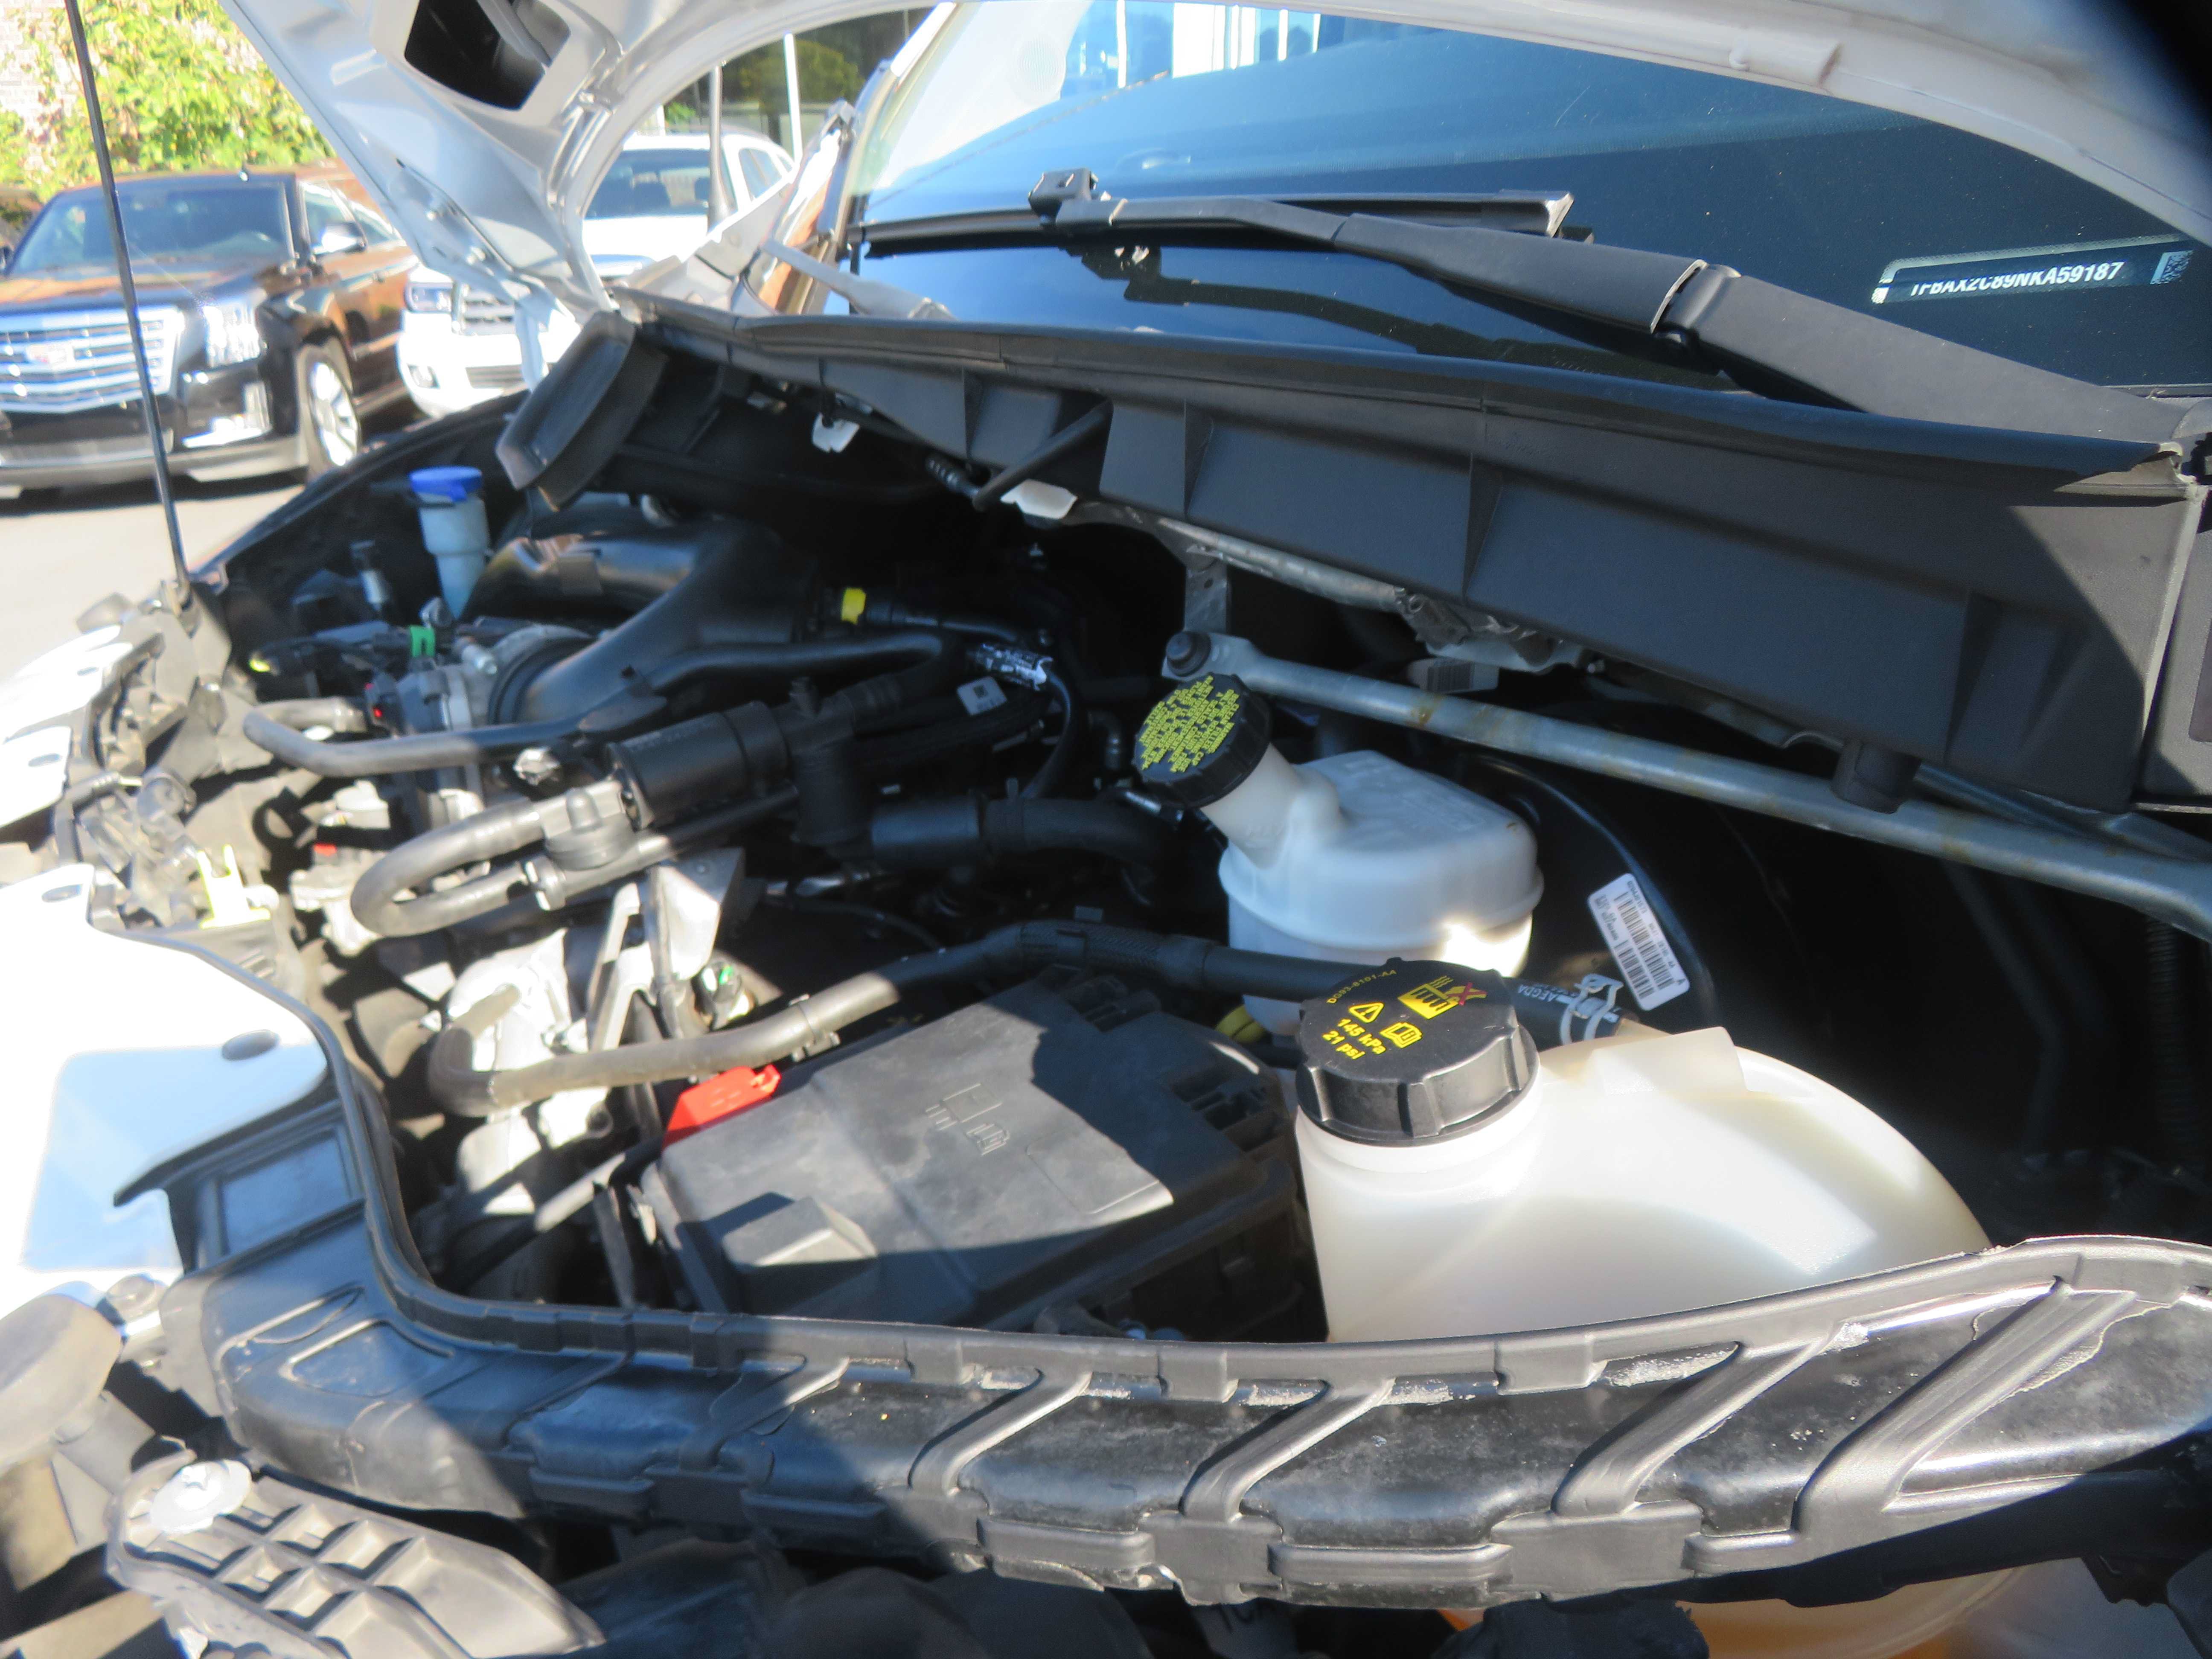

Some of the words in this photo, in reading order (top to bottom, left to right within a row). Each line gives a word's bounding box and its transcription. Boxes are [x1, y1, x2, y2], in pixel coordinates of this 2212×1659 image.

[1216, 693, 1239, 719] BEFORE
[1218, 690, 1234, 707] ONLY
[1195, 700, 1219, 725] SEALED
[1220, 702, 1239, 725] CLEAN
[1168, 726, 1198, 762] CONTAINER
[1185, 731, 1204, 750] FLUID
[1190, 719, 1220, 755] REMOVING
[1201, 727, 1223, 751] FILLER
[1207, 722, 1234, 753] WARNING
[1172, 752, 1187, 771] FROM
[1176, 757, 1192, 771] USE
[1190, 751, 1203, 765] CAP
[1322, 1030, 1345, 1045] 21
[1335, 1043, 1366, 1059] psi
[1338, 1019, 1365, 1037] 145
[1358, 1033, 1386, 1054] kPa
